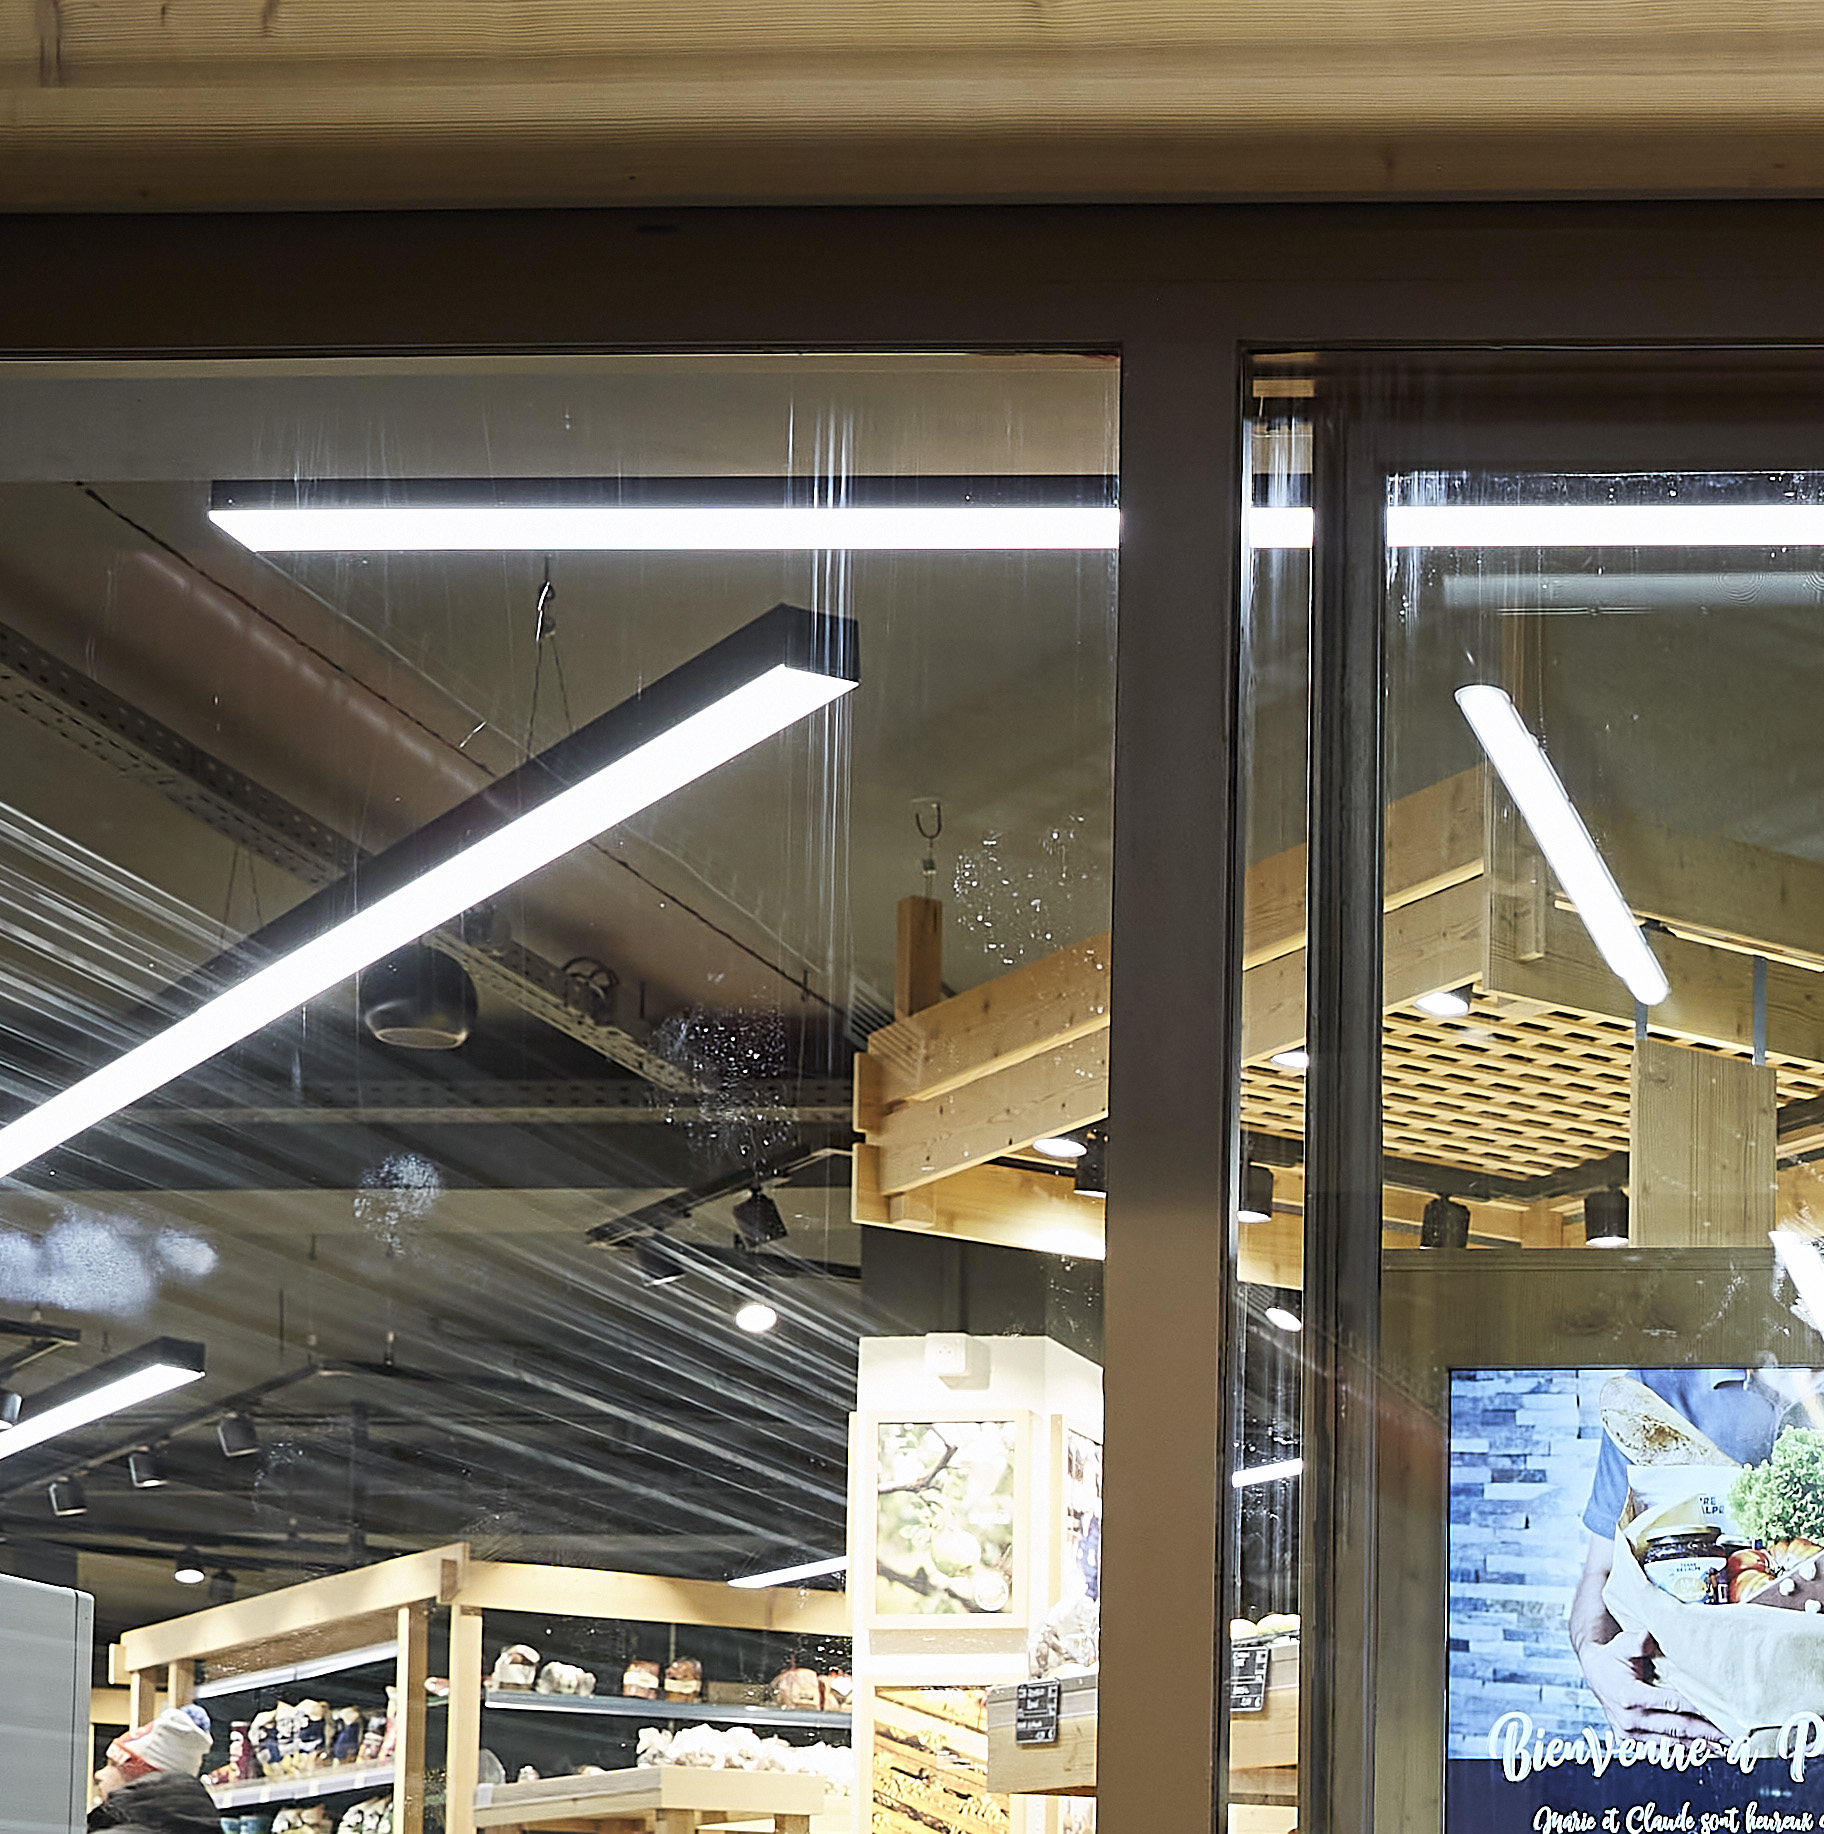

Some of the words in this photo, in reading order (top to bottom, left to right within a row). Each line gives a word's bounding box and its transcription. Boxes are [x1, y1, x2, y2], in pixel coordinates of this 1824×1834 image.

[1488, 1710, 1711, 1782] Bienvenue
[1532, 1805, 1597, 1834] Marie
[1602, 1806, 1621, 1832] et
[1626, 1802, 1697, 1834] Claude
[1746, 1801, 1813, 1833] heureux
